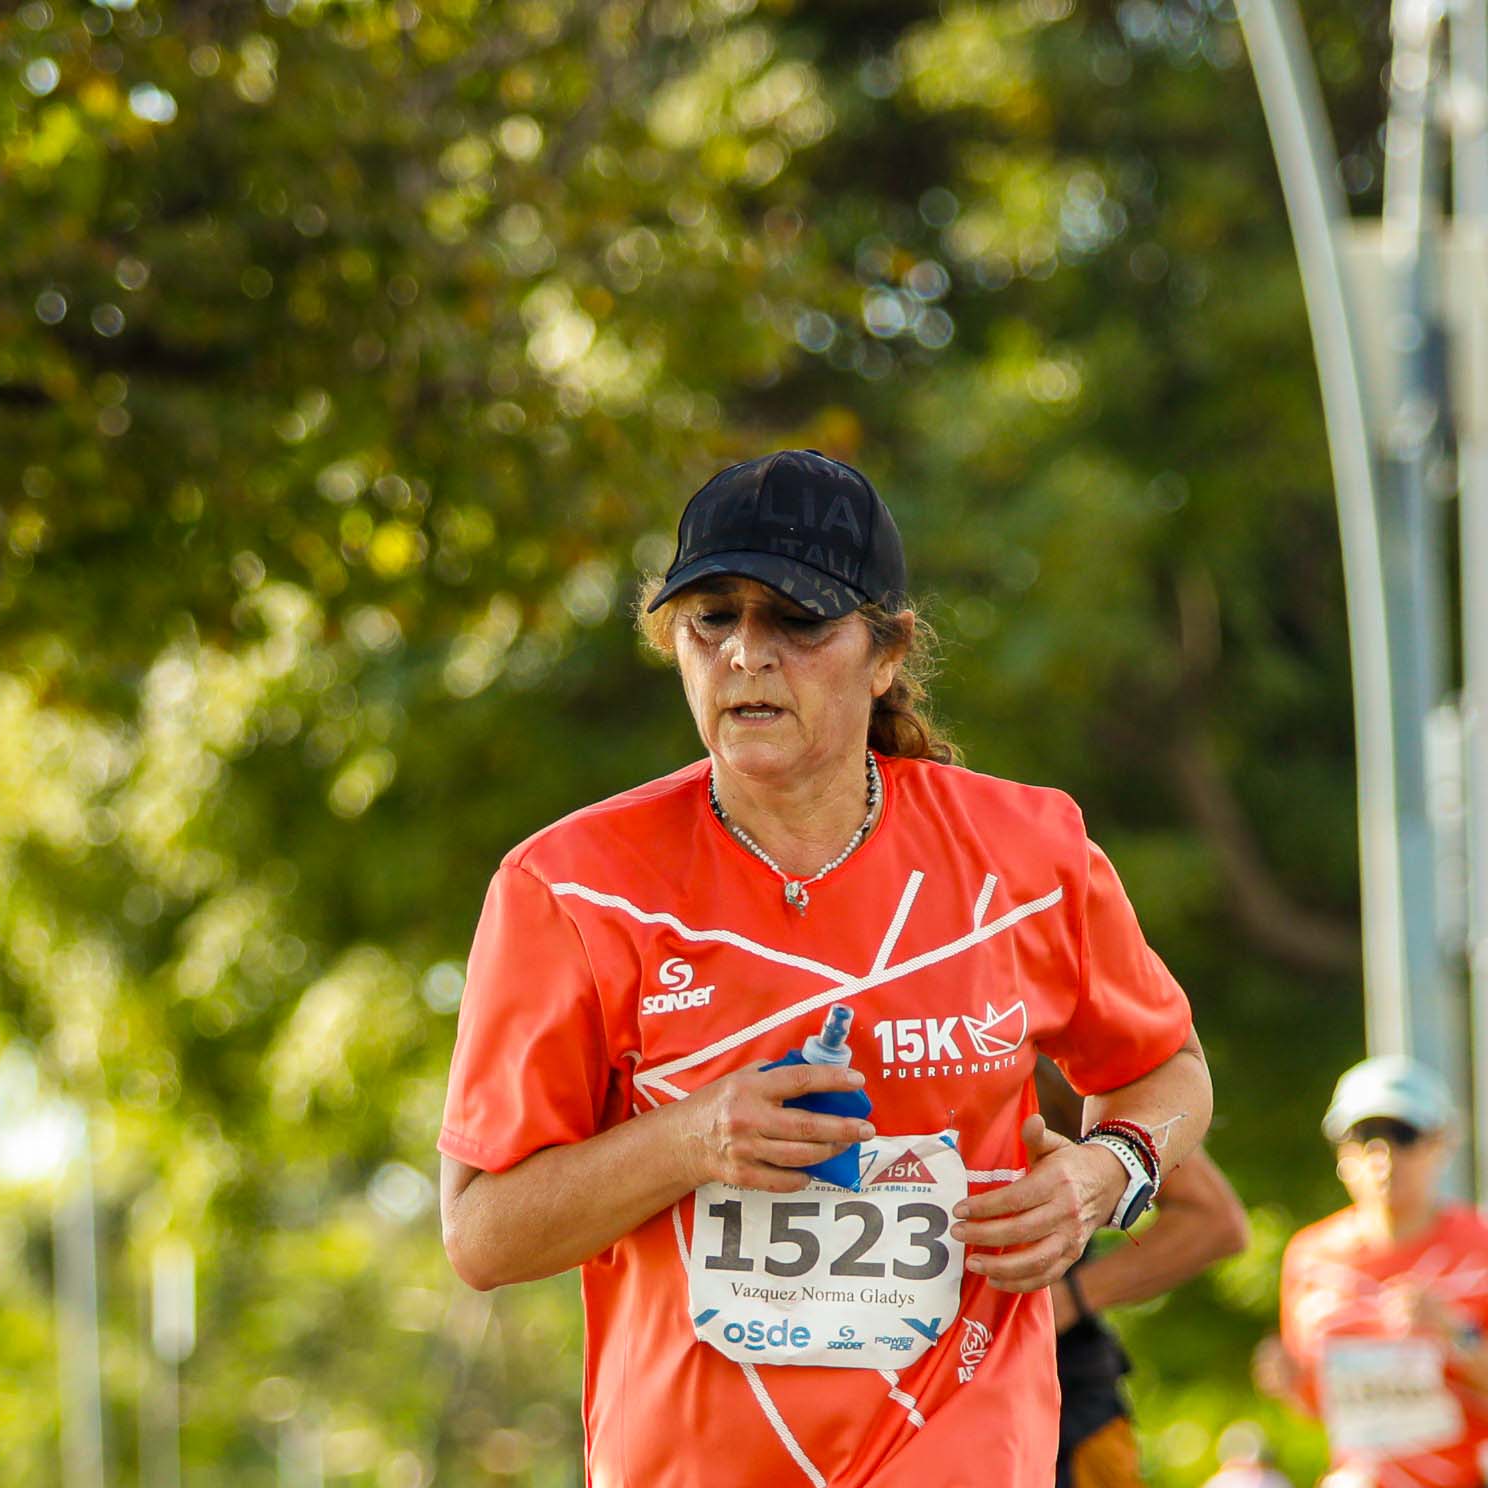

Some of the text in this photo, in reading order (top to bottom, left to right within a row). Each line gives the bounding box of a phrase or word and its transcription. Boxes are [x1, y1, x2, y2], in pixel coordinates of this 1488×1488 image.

[873, 1016, 964, 1064] 15K
[883, 1055, 1017, 1080] PUERTO NORTE
[887, 1161, 921, 1178] 15K
[704, 1200, 951, 1281] 1523
[730, 1282, 916, 1306] Vazquez Norma Gladys
[723, 1318, 812, 1350] osde
[874, 1335, 915, 1345] POWER
